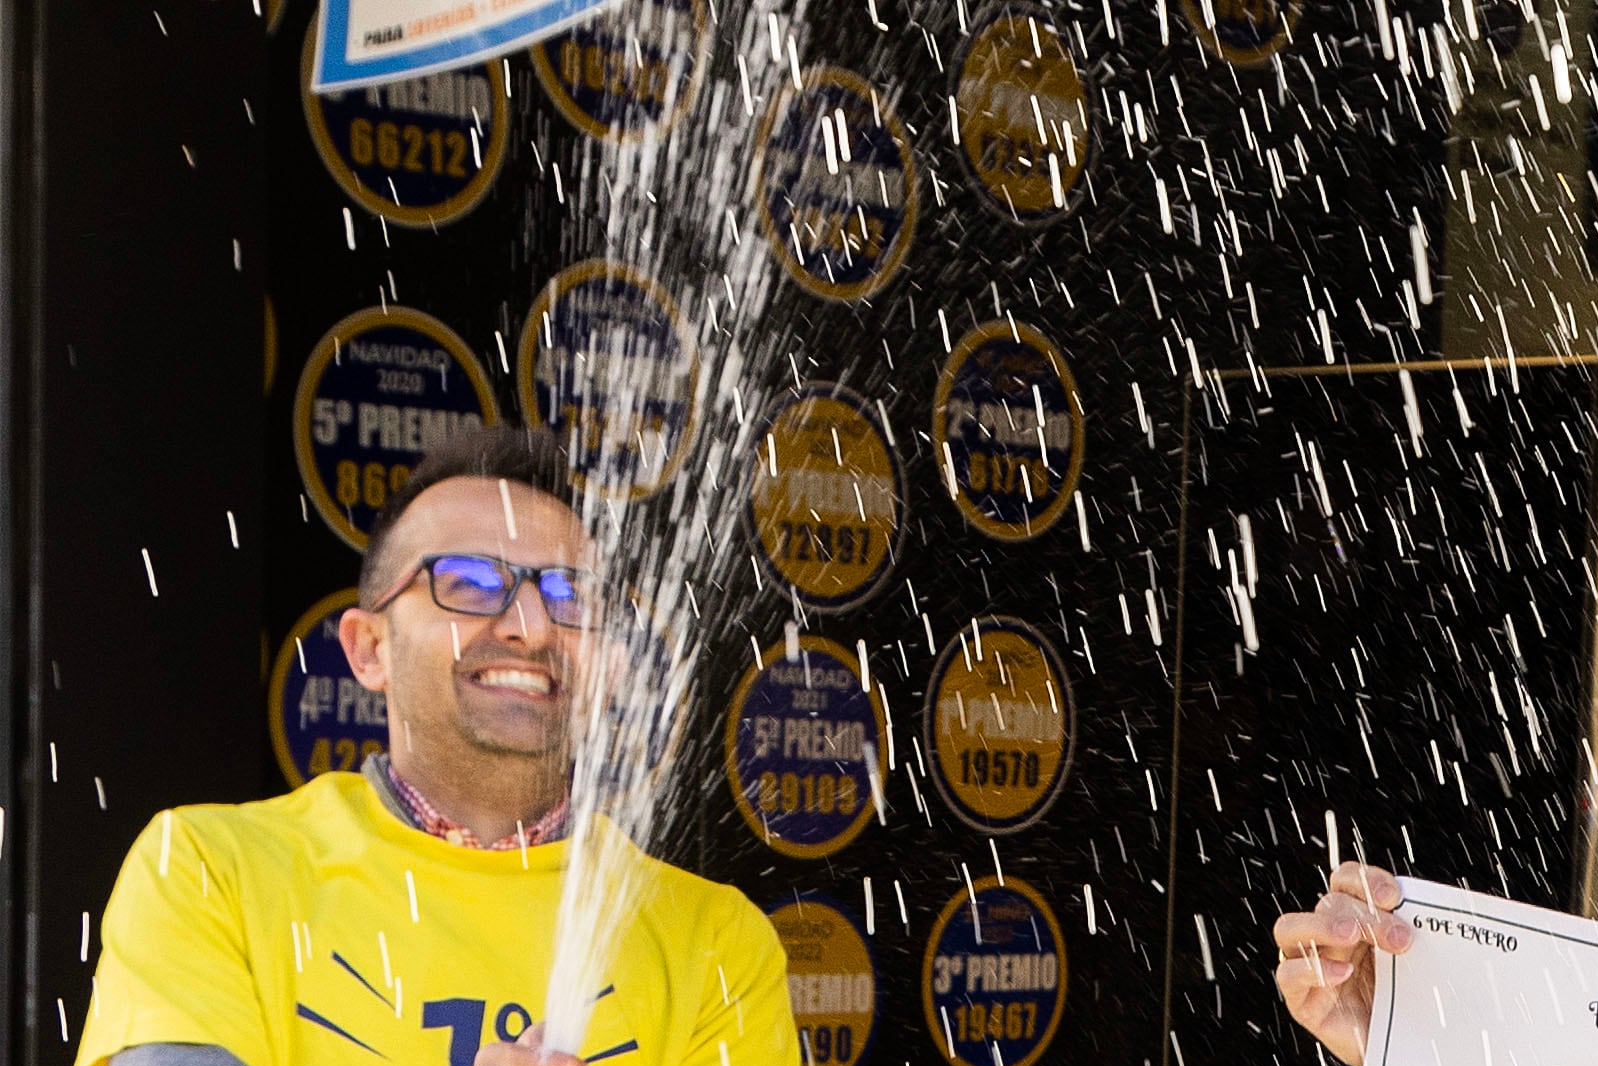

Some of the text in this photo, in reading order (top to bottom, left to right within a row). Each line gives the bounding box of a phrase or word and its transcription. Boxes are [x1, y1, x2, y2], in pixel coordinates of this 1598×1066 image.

[349, 117, 468, 178] 66212
[350, 341, 452, 371] NAVIDAD
[783, 717, 866, 762] PREMIO
[959, 749, 1040, 788] 19570
[1413, 914, 1518, 953] 6 DE ENERO
[966, 952, 1058, 993] PREMIO
[954, 1000, 1038, 1044] 19467
